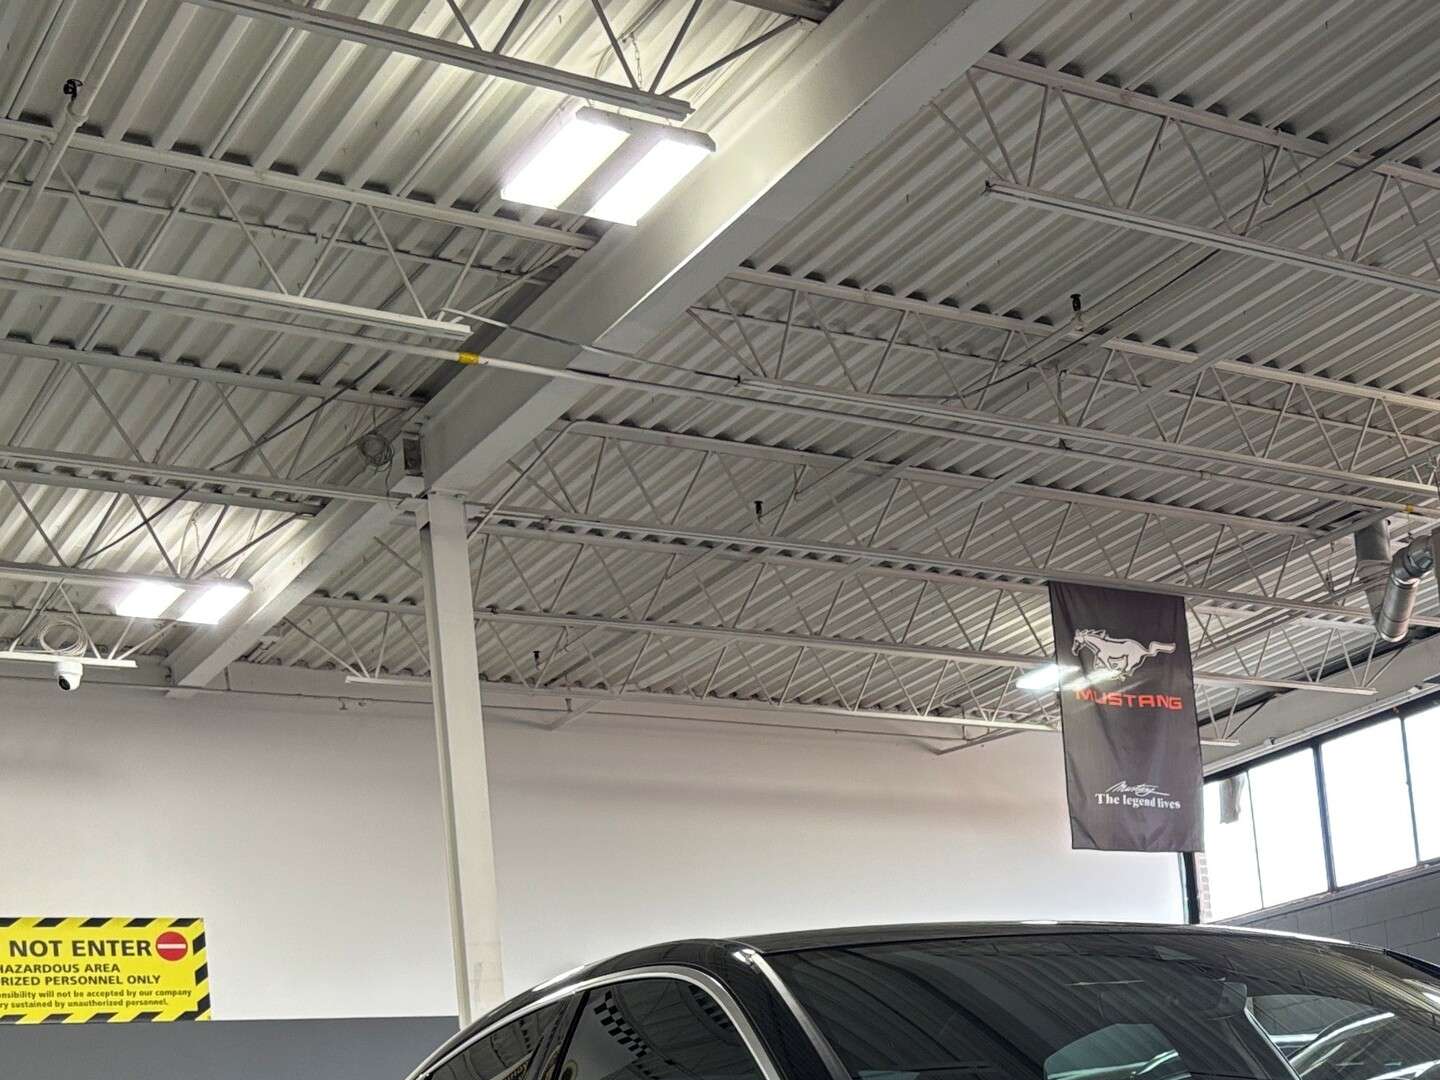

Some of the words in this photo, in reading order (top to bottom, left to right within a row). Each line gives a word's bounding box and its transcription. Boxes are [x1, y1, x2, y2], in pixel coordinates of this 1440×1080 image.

[1074, 688, 1183, 711] MUSTANG
[1095, 793, 1120, 805] The
[1123, 794, 1156, 809] legend
[1157, 797, 1181, 809] lives
[9, 940, 63, 957] NOT
[72, 940, 152, 957] ENTER
[84, 963, 120, 973] AREA
[0, 976, 41, 986] RIZED
[45, 975, 123, 986] PERSONNEL
[127, 975, 161, 985] ONLY
[0, 990, 36, 1000] nsibility
[39, 990, 54, 998] will
[56, 990, 71, 998] not
[74, 989, 84, 997] be
[87, 989, 124, 998] accepted
[127, 989, 137, 998] by
[155, 989, 192, 998] company
[0, 1001, 9, 1010] ry
[11, 1000, 52, 1008] sustained
[55, 1000, 65, 1009] by
[68, 998, 123, 1007] unauthorized
